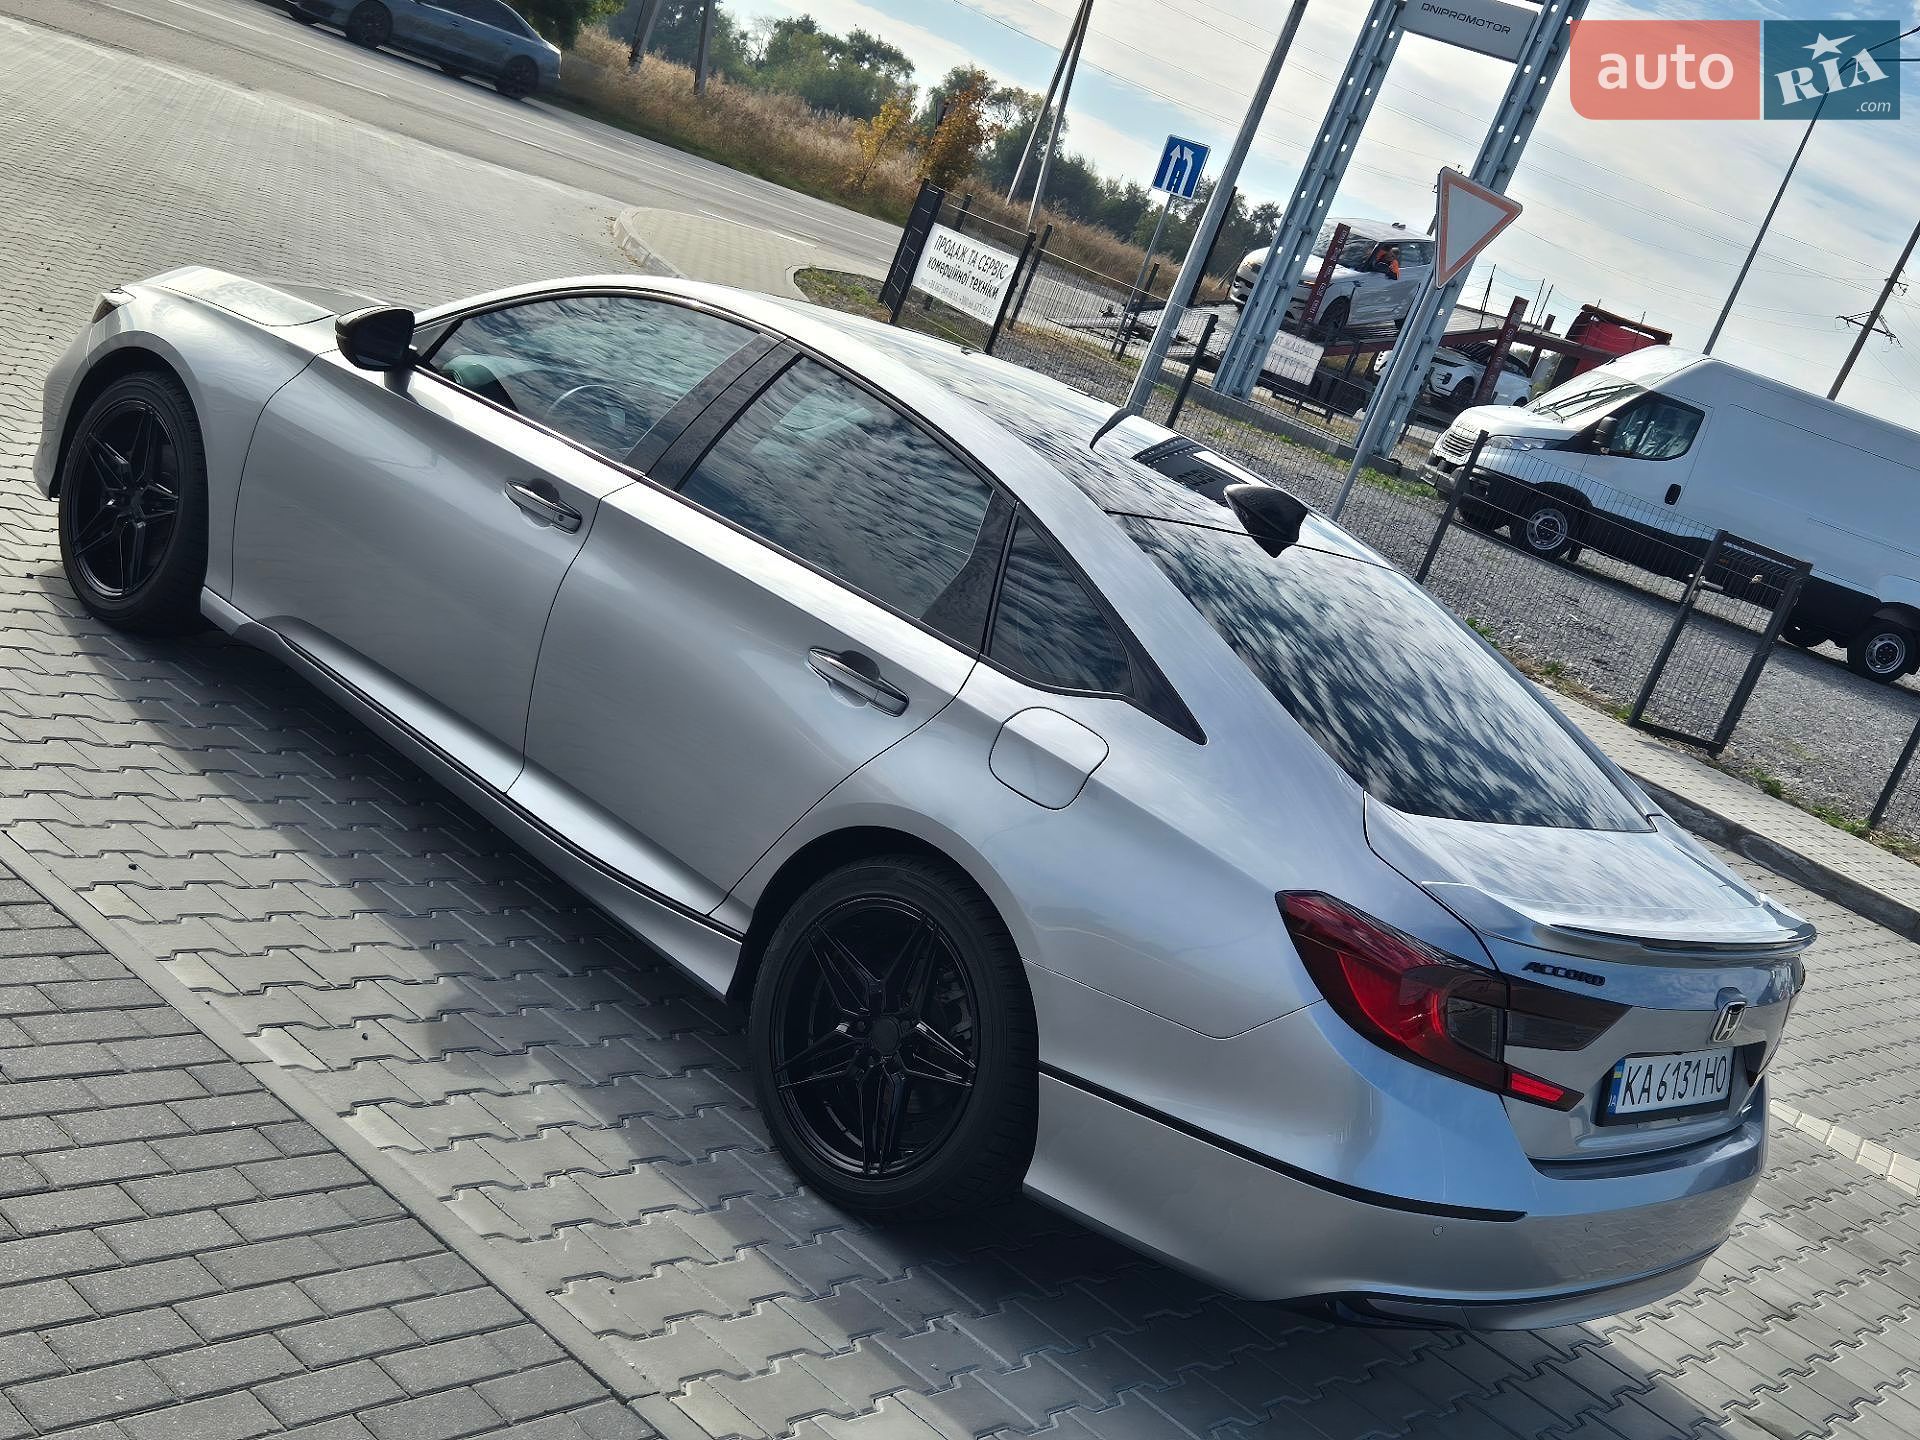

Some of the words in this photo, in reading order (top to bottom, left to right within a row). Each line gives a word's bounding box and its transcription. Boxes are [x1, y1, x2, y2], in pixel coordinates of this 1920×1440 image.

[1421, 2, 1511, 34] DNIPROMOTOR
[933, 234, 969, 263] ПРОДАЖ
[967, 249, 979, 268] ТА
[977, 254, 1009, 280] СЕРВІС
[1521, 961, 1606, 987] ACCORD
[1621, 1064, 1653, 1107] KA
[1656, 1059, 1702, 1102] 6131
[1701, 1055, 1728, 1097] HO
